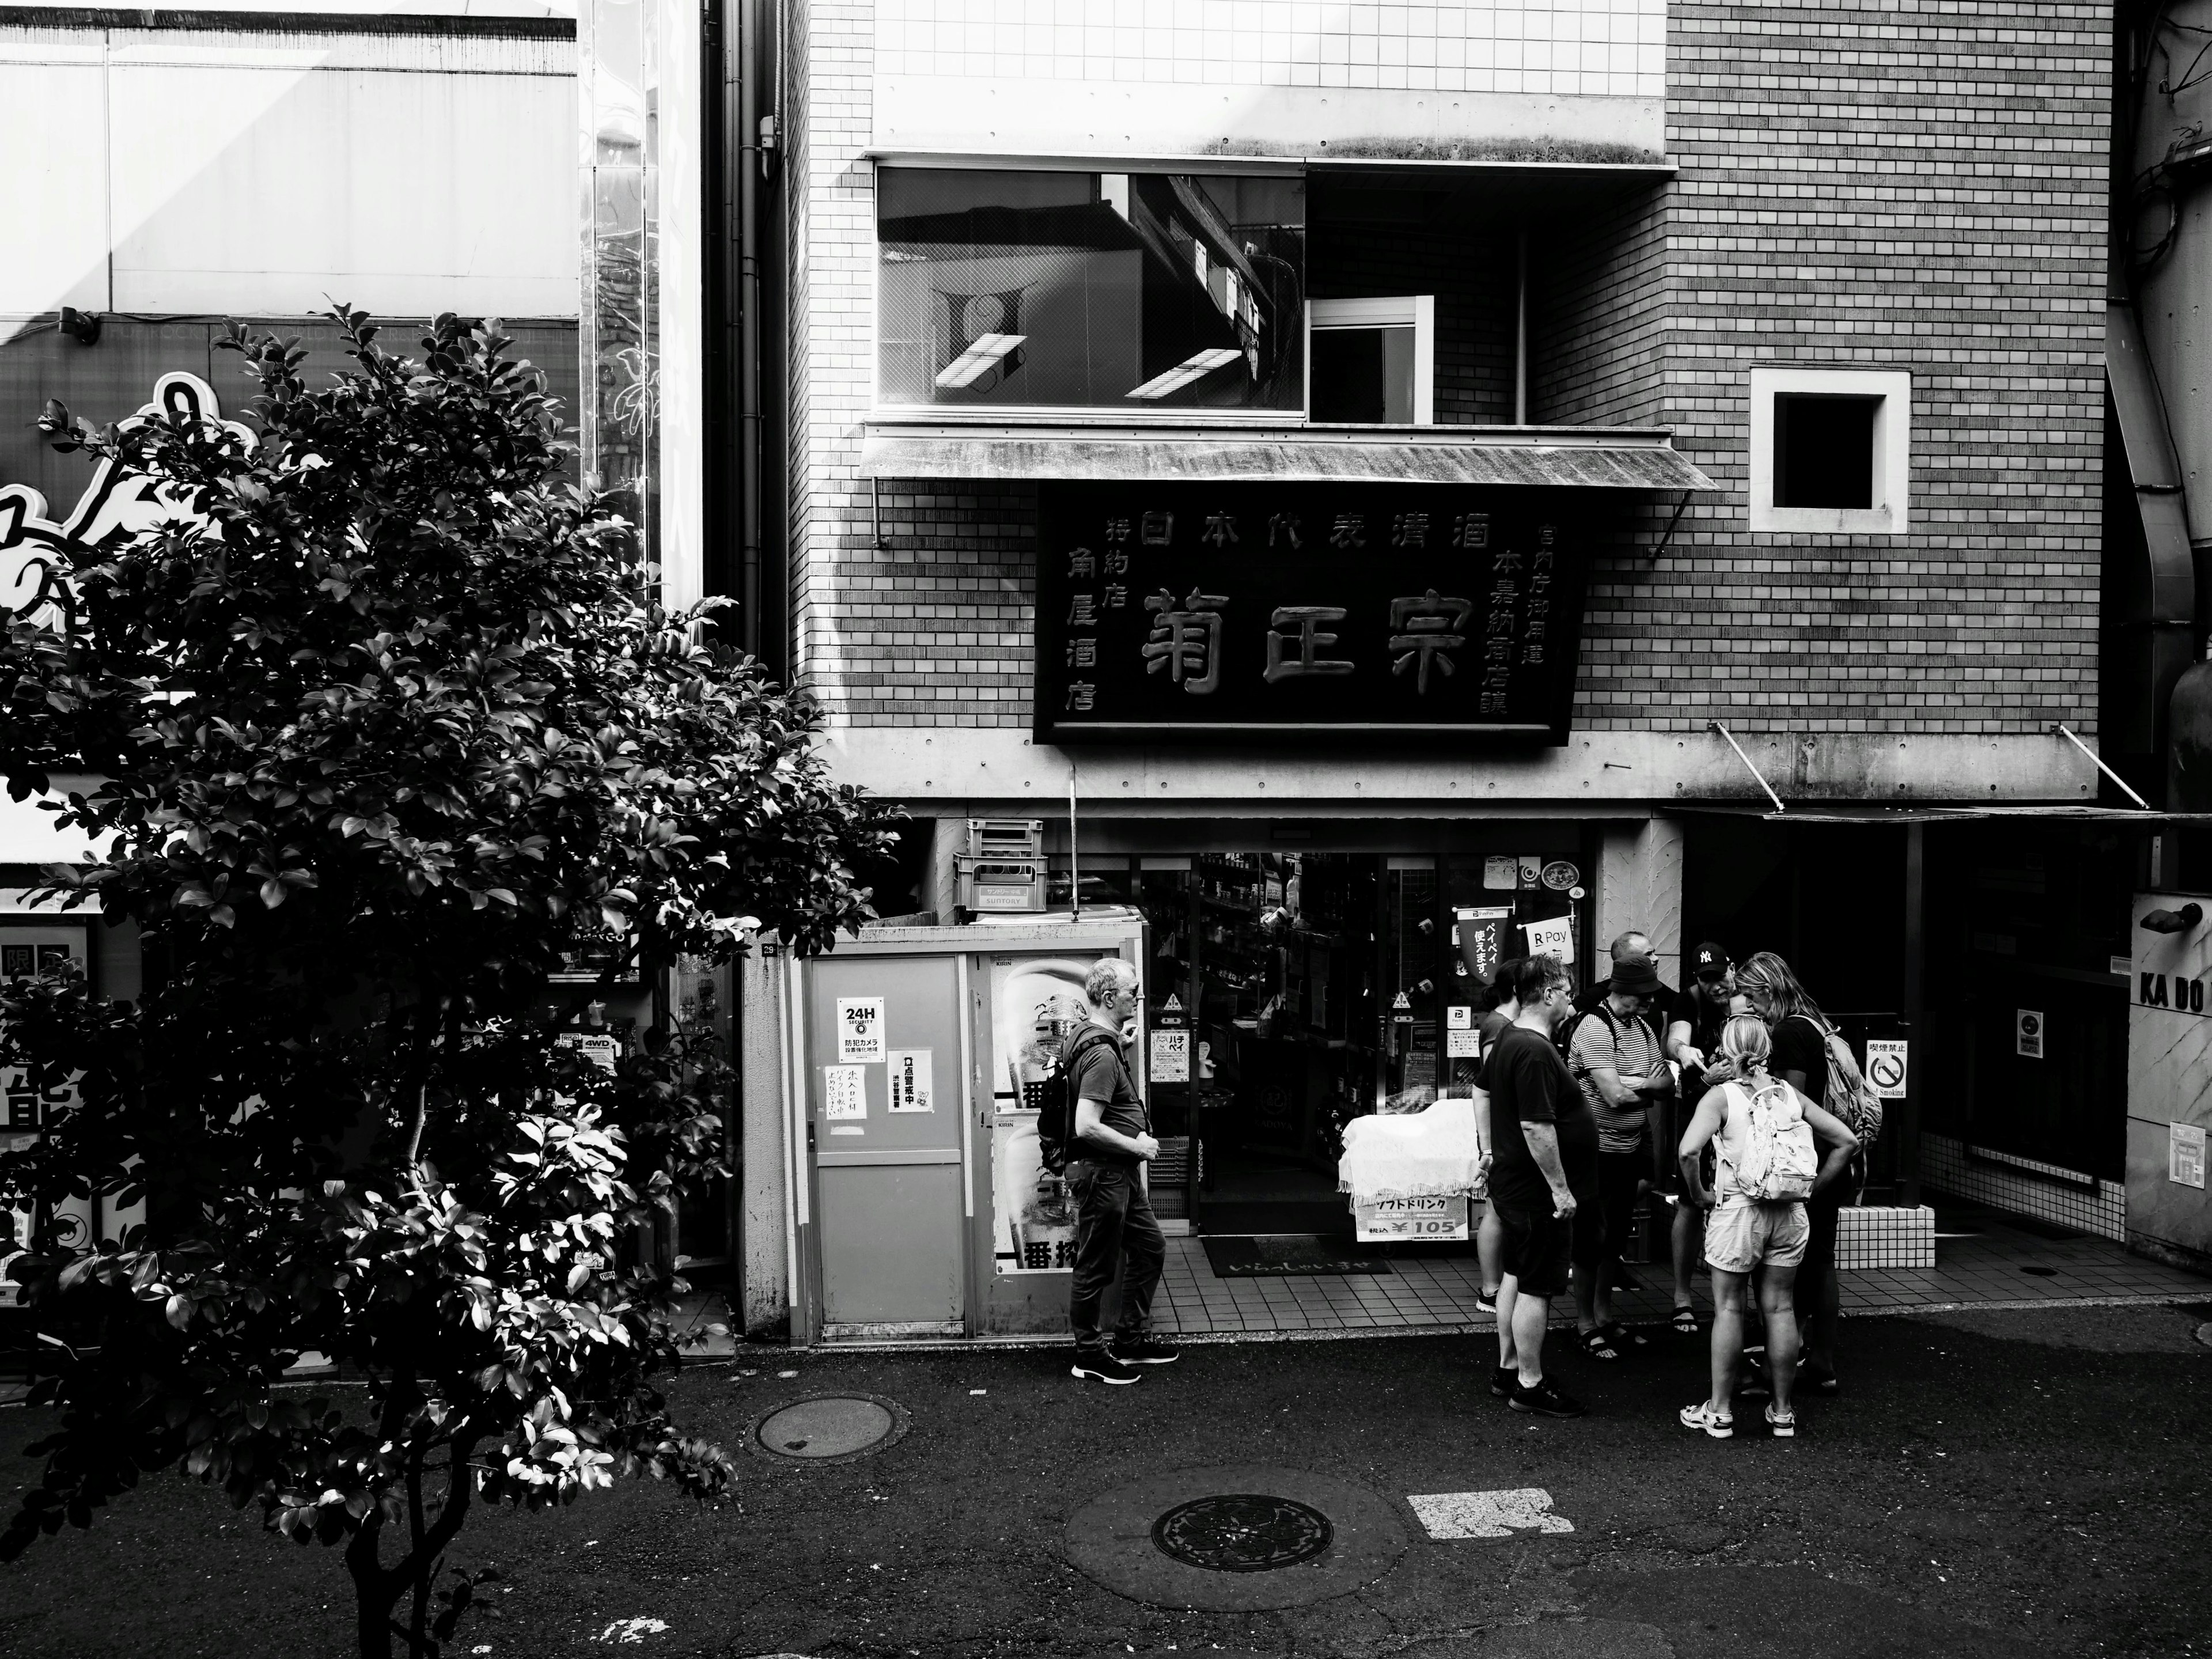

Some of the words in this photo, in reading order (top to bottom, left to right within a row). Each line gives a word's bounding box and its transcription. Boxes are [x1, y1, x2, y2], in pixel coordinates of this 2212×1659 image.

[1141, 511, 1491, 550] 日本代表清酒
[1102, 516, 1132, 608] 特約店
[1066, 547, 1097, 711] 角屋酒店
[1141, 587, 1474, 695] 菊正宗
[1486, 922, 1498, 964] ペイペイ
[1546, 931, 1567, 943] Pay
[1474, 930, 1488, 977] 使えます。
[1700, 950, 1712, 963] NY
[846, 1007, 875, 1020] 24H
[845, 1039, 878, 1047] 防犯カメラ
[1869, 1043, 1906, 1052] 喫煙禁止
[1880, 1088, 1904, 1096] Smoking
